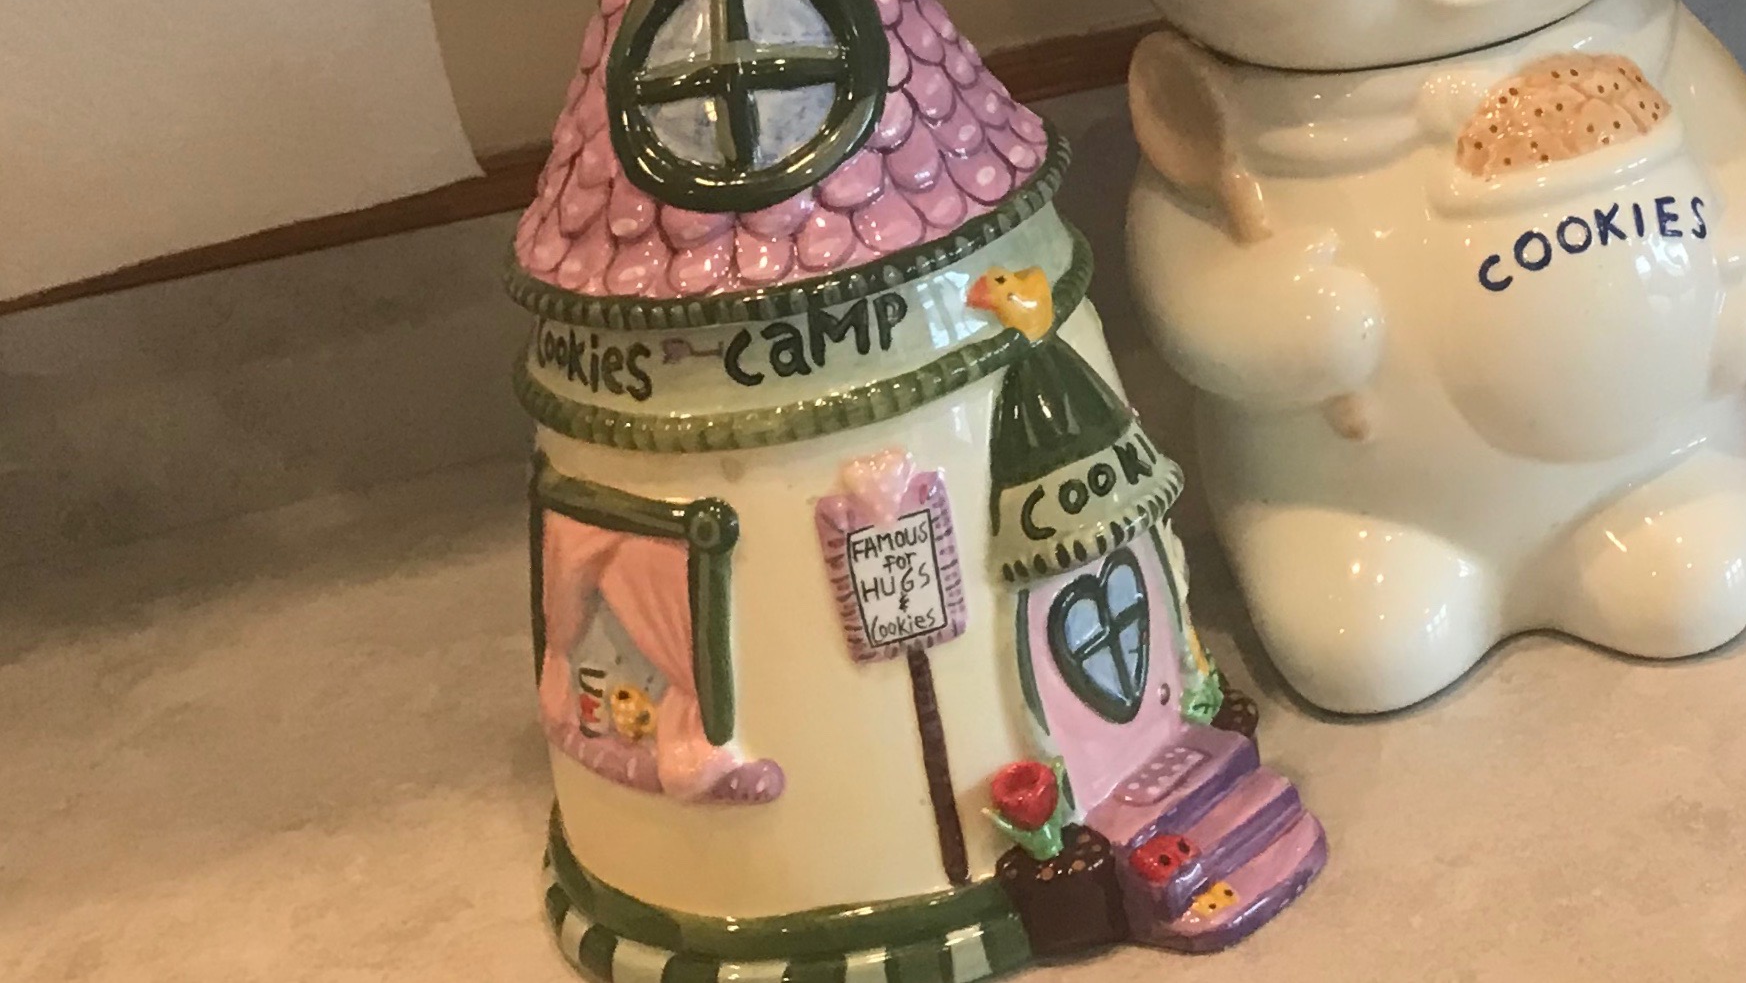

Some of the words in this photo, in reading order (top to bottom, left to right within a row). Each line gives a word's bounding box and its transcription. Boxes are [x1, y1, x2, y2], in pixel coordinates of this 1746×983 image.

[1478, 196, 1708, 292] COOKIES
[851, 521, 928, 563] FAMOUS
[861, 562, 931, 603] HUGS
[871, 607, 936, 643] Cookies
